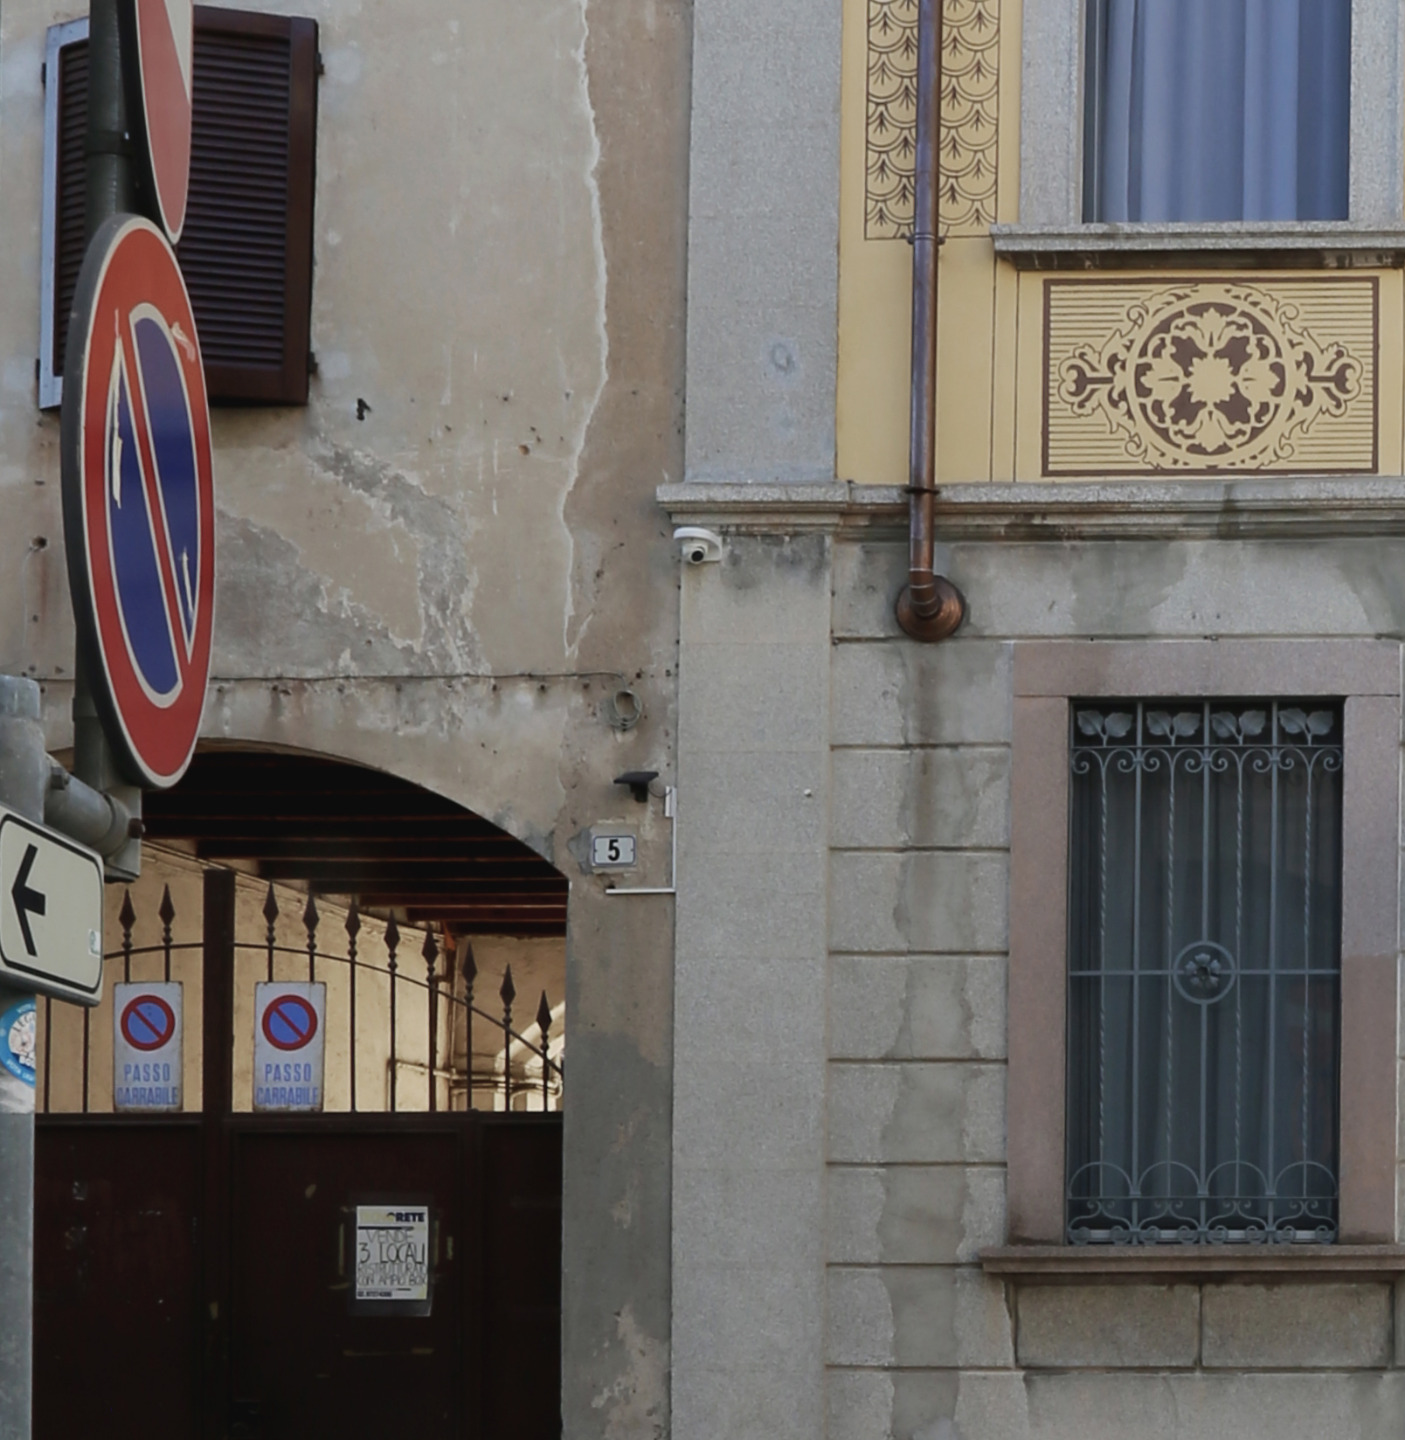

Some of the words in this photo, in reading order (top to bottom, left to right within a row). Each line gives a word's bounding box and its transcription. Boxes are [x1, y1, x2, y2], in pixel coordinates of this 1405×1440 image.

[607, 838, 621, 862] 5
[123, 1062, 171, 1082] PASSO
[264, 1062, 312, 1082] PASSO
[116, 1086, 179, 1106] CARRABILE
[256, 1086, 319, 1106] CARRABILE
[365, 1229, 414, 1244] VENDE
[358, 1242, 371, 1264] 3
[379, 1242, 425, 1264] LOCALI
